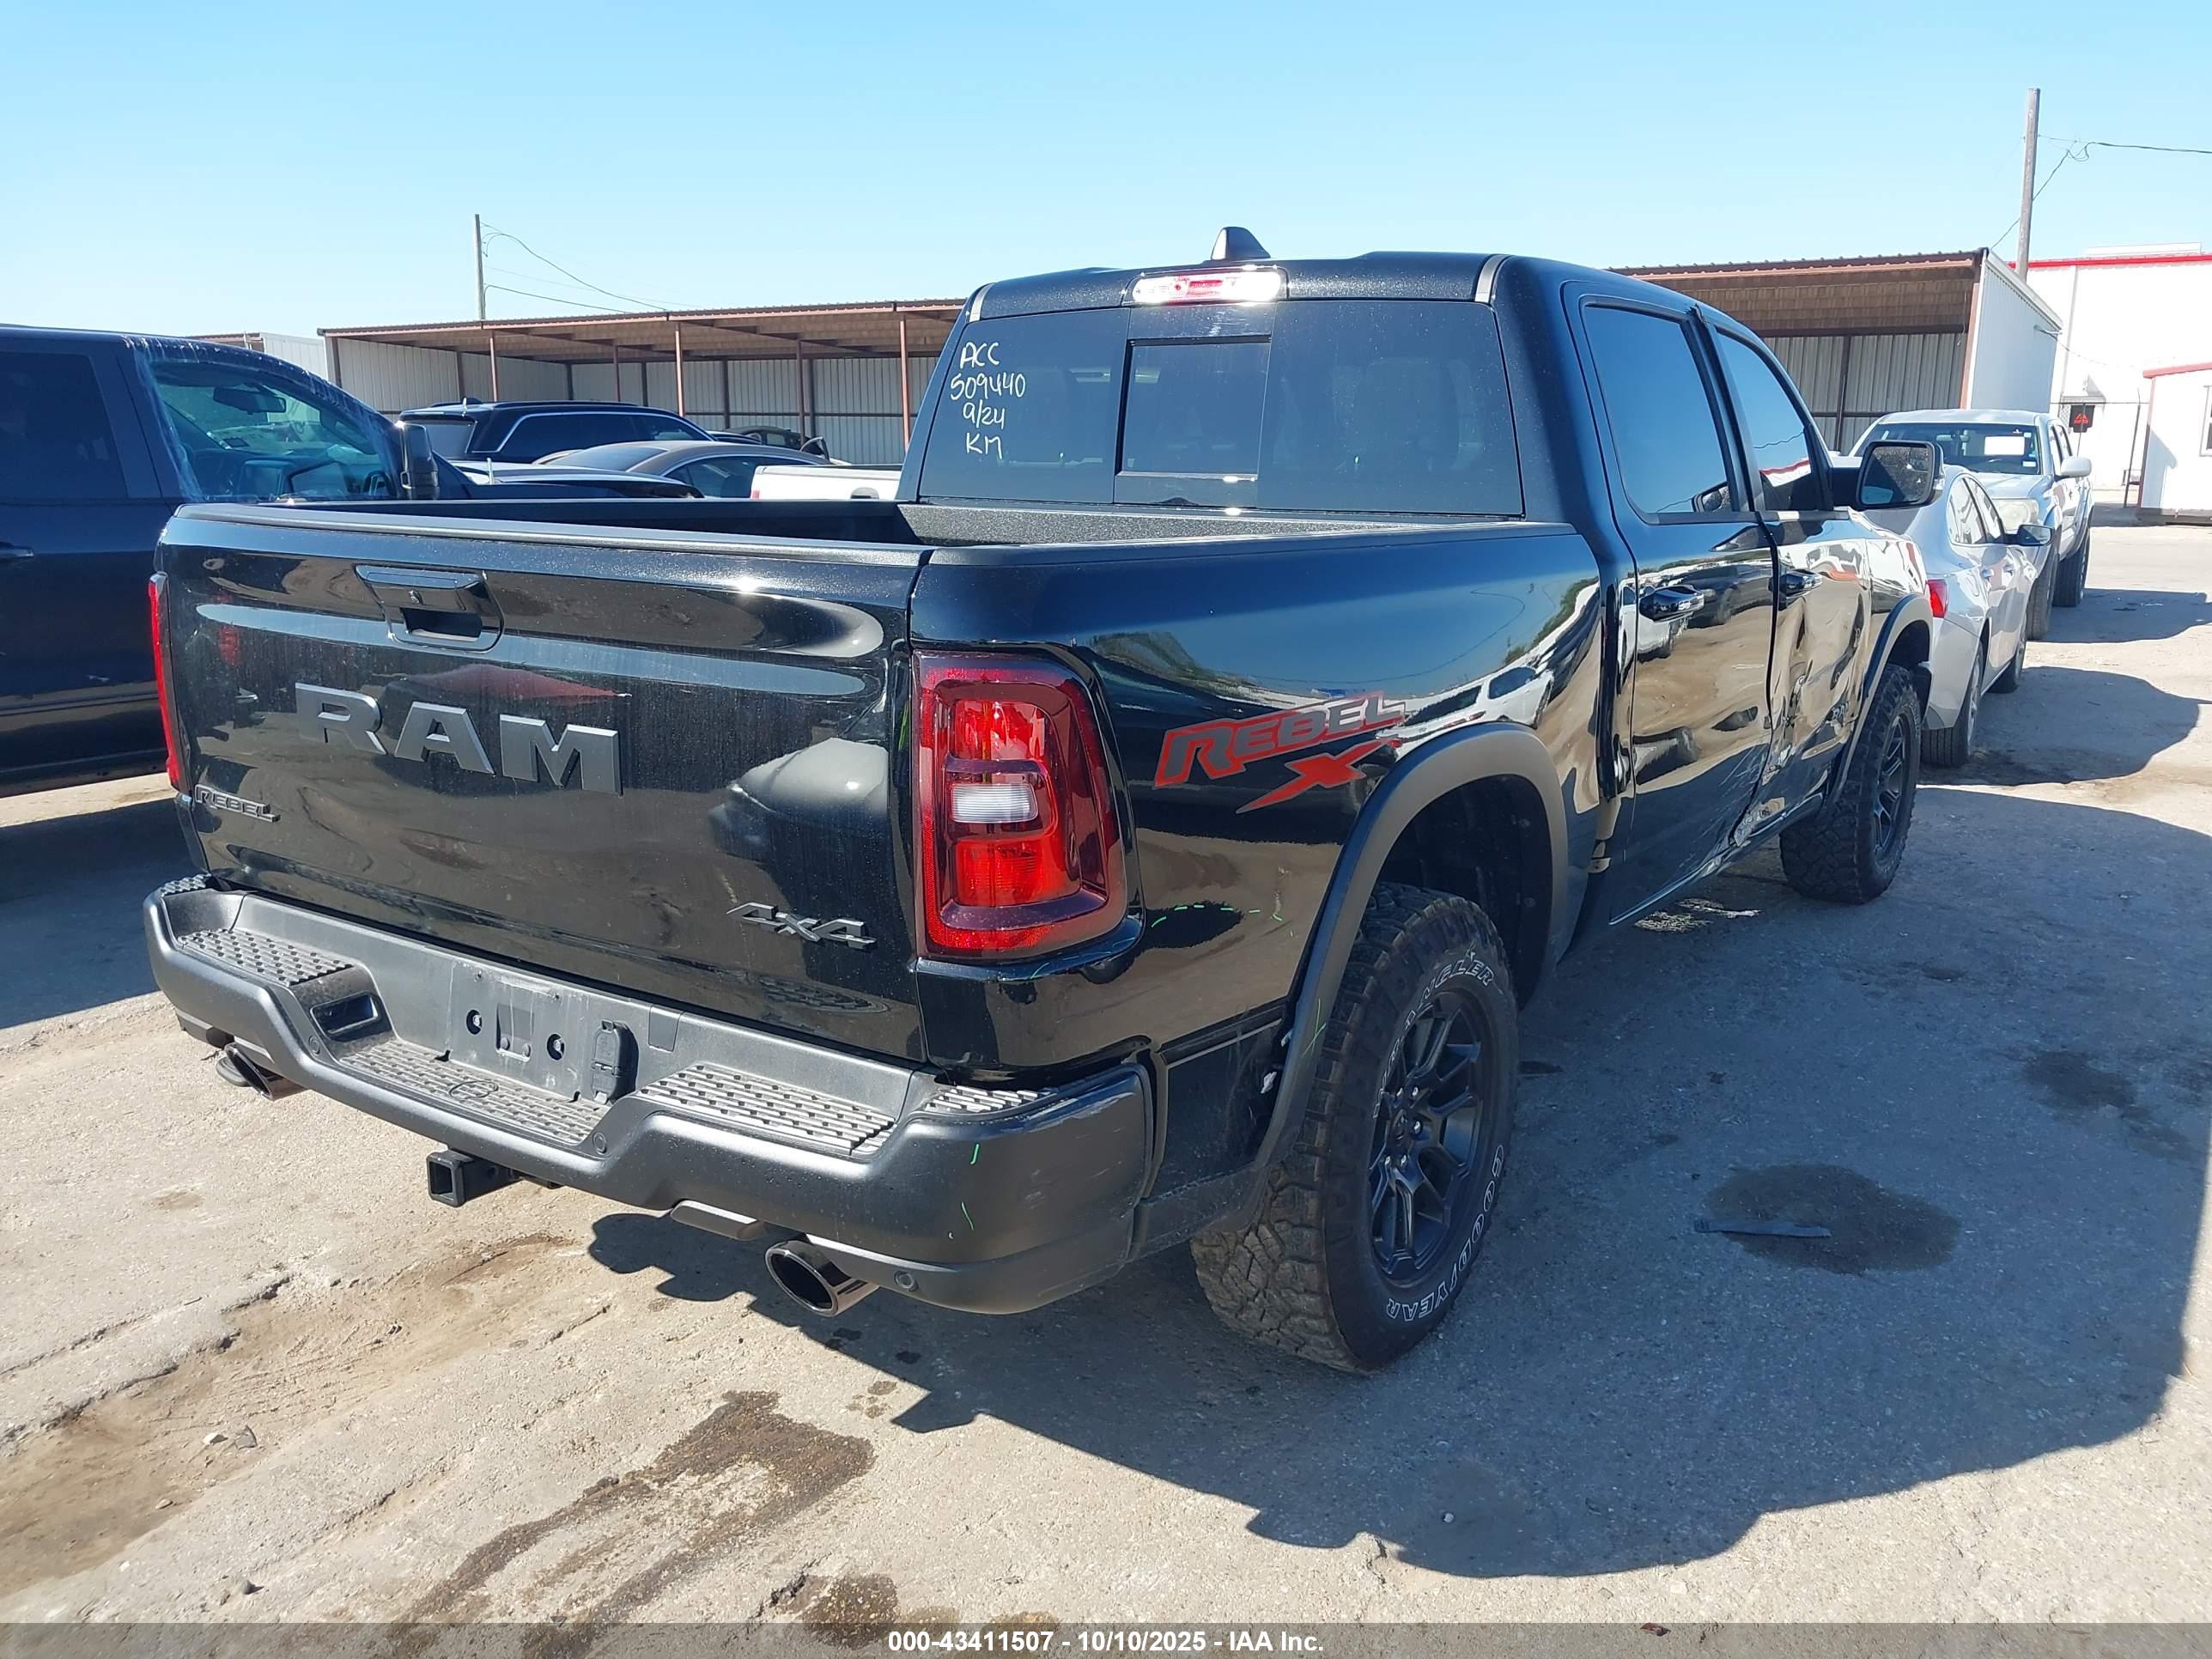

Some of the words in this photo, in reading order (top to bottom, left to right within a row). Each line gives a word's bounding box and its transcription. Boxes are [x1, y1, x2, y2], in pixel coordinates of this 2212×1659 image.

[960, 342, 1000, 369] ACC
[950, 371, 1026, 401] 509440
[963, 399, 1006, 429] 9/24
[295, 682, 623, 797] RAM
[1153, 691, 1407, 788] REBEL
[195, 784, 282, 823] REBEL
[1386, 1145, 1504, 1322] GOODYEAR
